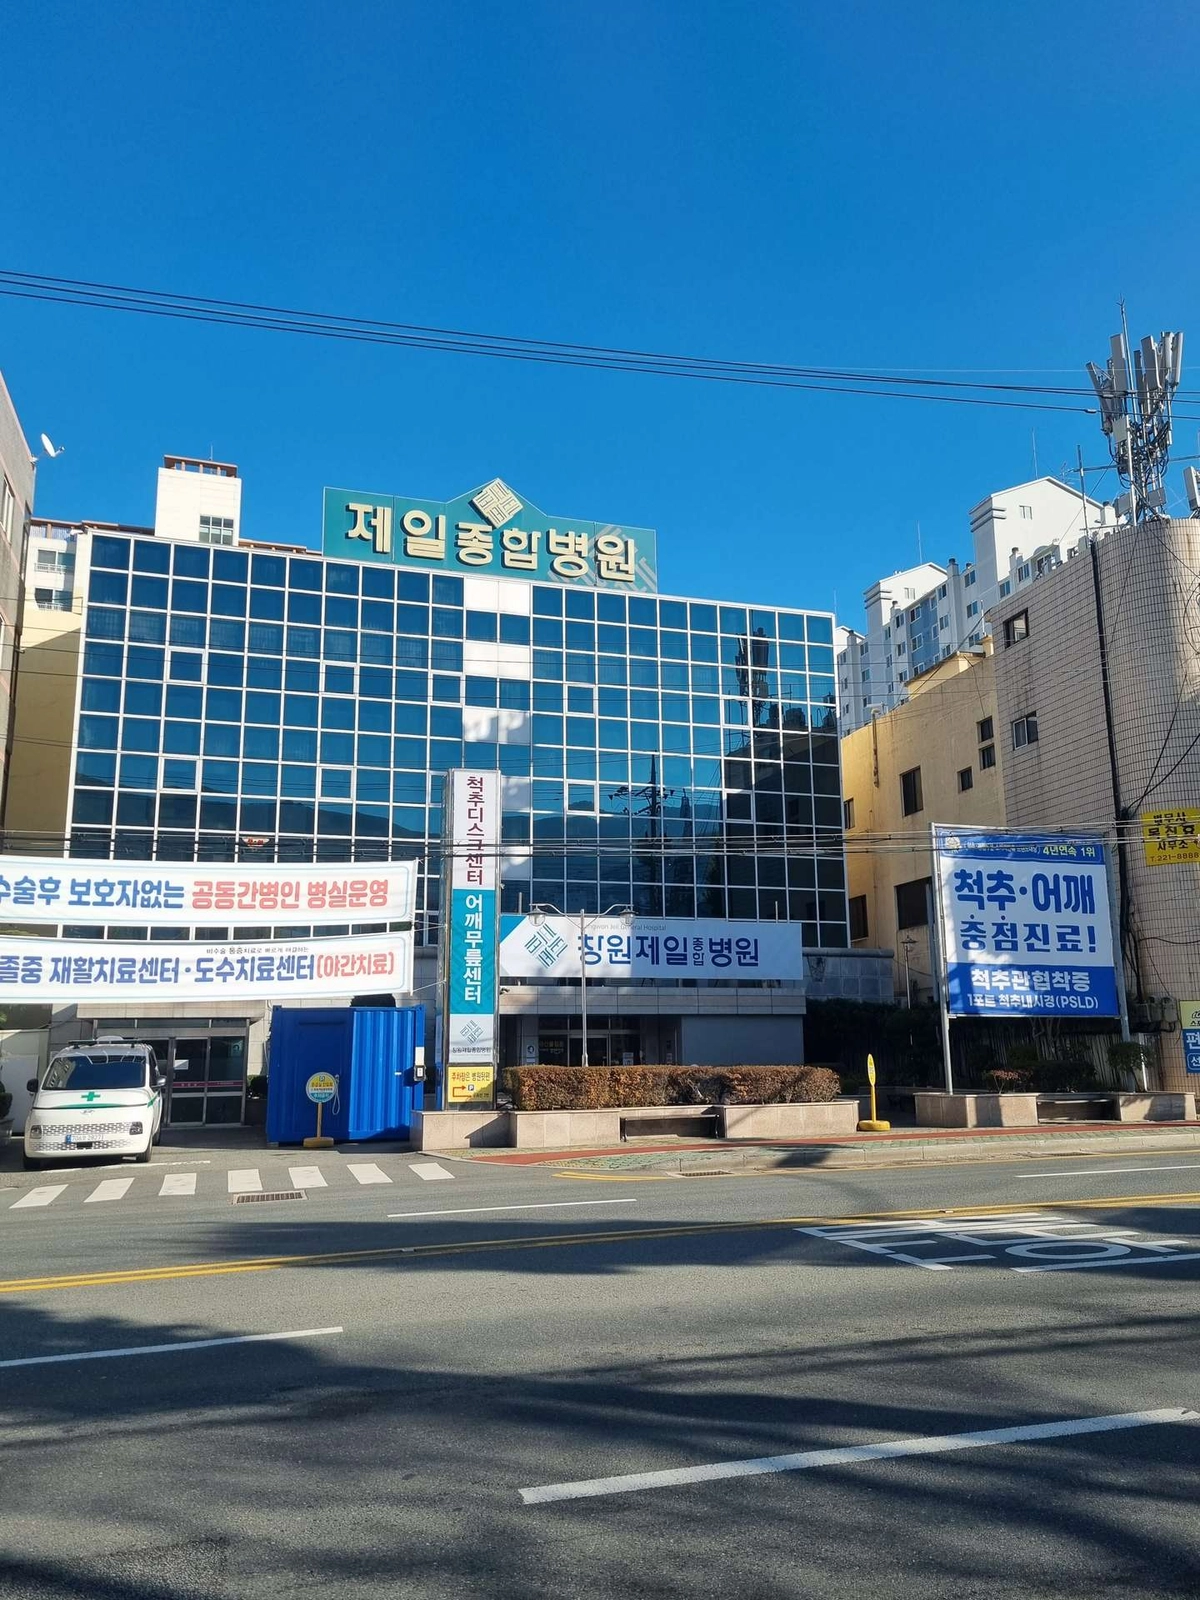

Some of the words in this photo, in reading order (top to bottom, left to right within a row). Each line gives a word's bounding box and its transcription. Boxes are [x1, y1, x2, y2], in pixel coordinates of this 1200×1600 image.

[347, 503, 636, 583] 제일종합병원
[466, 775, 485, 886] 척추디스크센터
[1043, 845, 1077, 856] 4년연속
[1081, 846, 1095, 857] 1위
[1157, 839, 1189, 851] 사무소
[68, 877, 185, 909] 보호자없는
[192, 879, 300, 910] 공동간병인
[307, 879, 389, 908] 병실운영
[643, 923, 667, 932] Hospital
[463, 893, 485, 1004] 어깨무릎센터
[970, 969, 1090, 992] 척추관협착증
